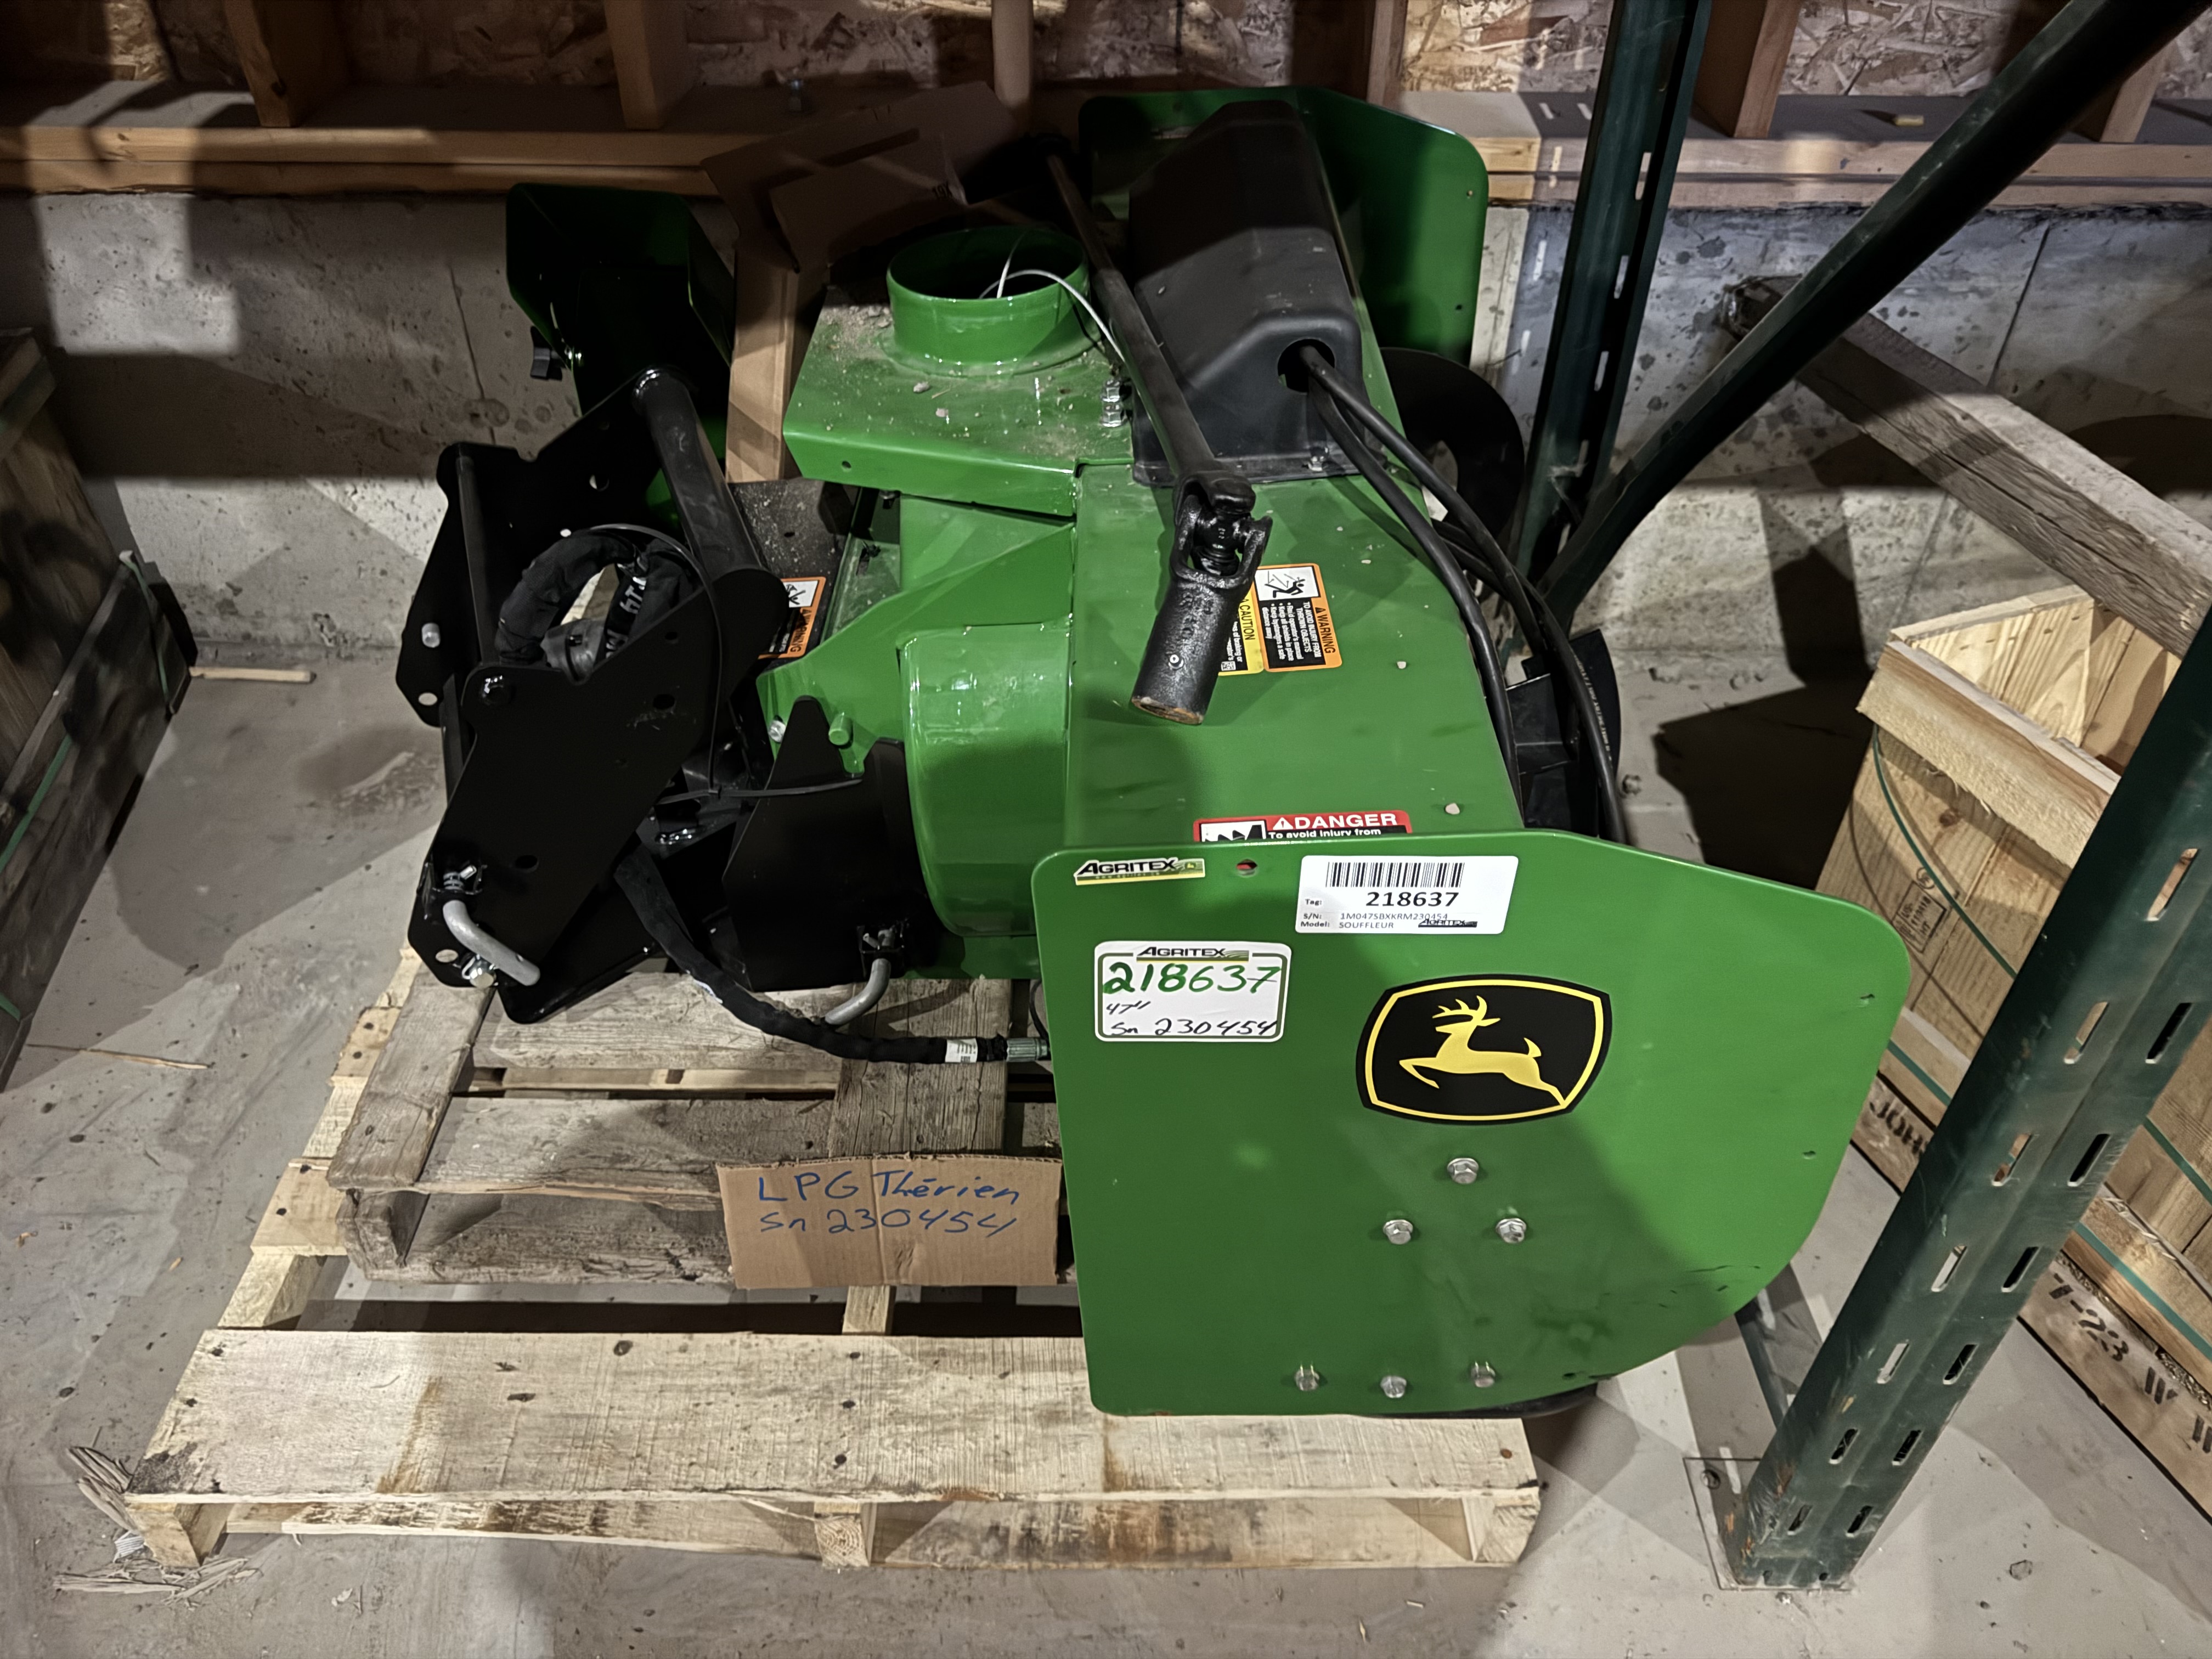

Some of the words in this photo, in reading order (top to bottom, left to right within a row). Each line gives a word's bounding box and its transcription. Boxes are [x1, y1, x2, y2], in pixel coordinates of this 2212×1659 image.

[1239, 605, 1256, 640] CAUTION
[1262, 607, 1271, 627] distance
[1296, 607, 1306, 629] THROWN
[1305, 609, 1314, 623] AVOID
[790, 613, 811, 652] WARNING
[1271, 619, 1282, 645] bystanders
[1278, 648, 1286, 659] safe
[1282, 625, 1291, 642] shields
[1288, 618, 1300, 641] operator's
[1294, 641, 1304, 659] manual
[1300, 629, 1312, 652] OBJECTS
[1308, 624, 1318, 642] INJURY
[1317, 613, 1336, 653] WARNING
[1234, 637, 1242, 656] braking
[1285, 648, 1294, 661] place
[1312, 642, 1322, 657] FROM
[1295, 813, 1397, 830] DANGER
[1268, 831, 1283, 839] To
[1286, 830, 1317, 839] avoid
[1354, 828, 1381, 836] from
[1078, 860, 1177, 876] AGRITEX
[1365, 891, 1459, 907] 218637
[1137, 946, 1226, 957] AGRITEX
[1102, 962, 1282, 994] 218637
[1110, 1022, 1138, 1036] Sn
[1154, 1018, 1278, 1036] 230454
[1870, 1102, 1928, 1155] JOH
[759, 1170, 860, 1202] LPG
[760, 1211, 806, 1233] Sn
[827, 1209, 1017, 1238] 230454
